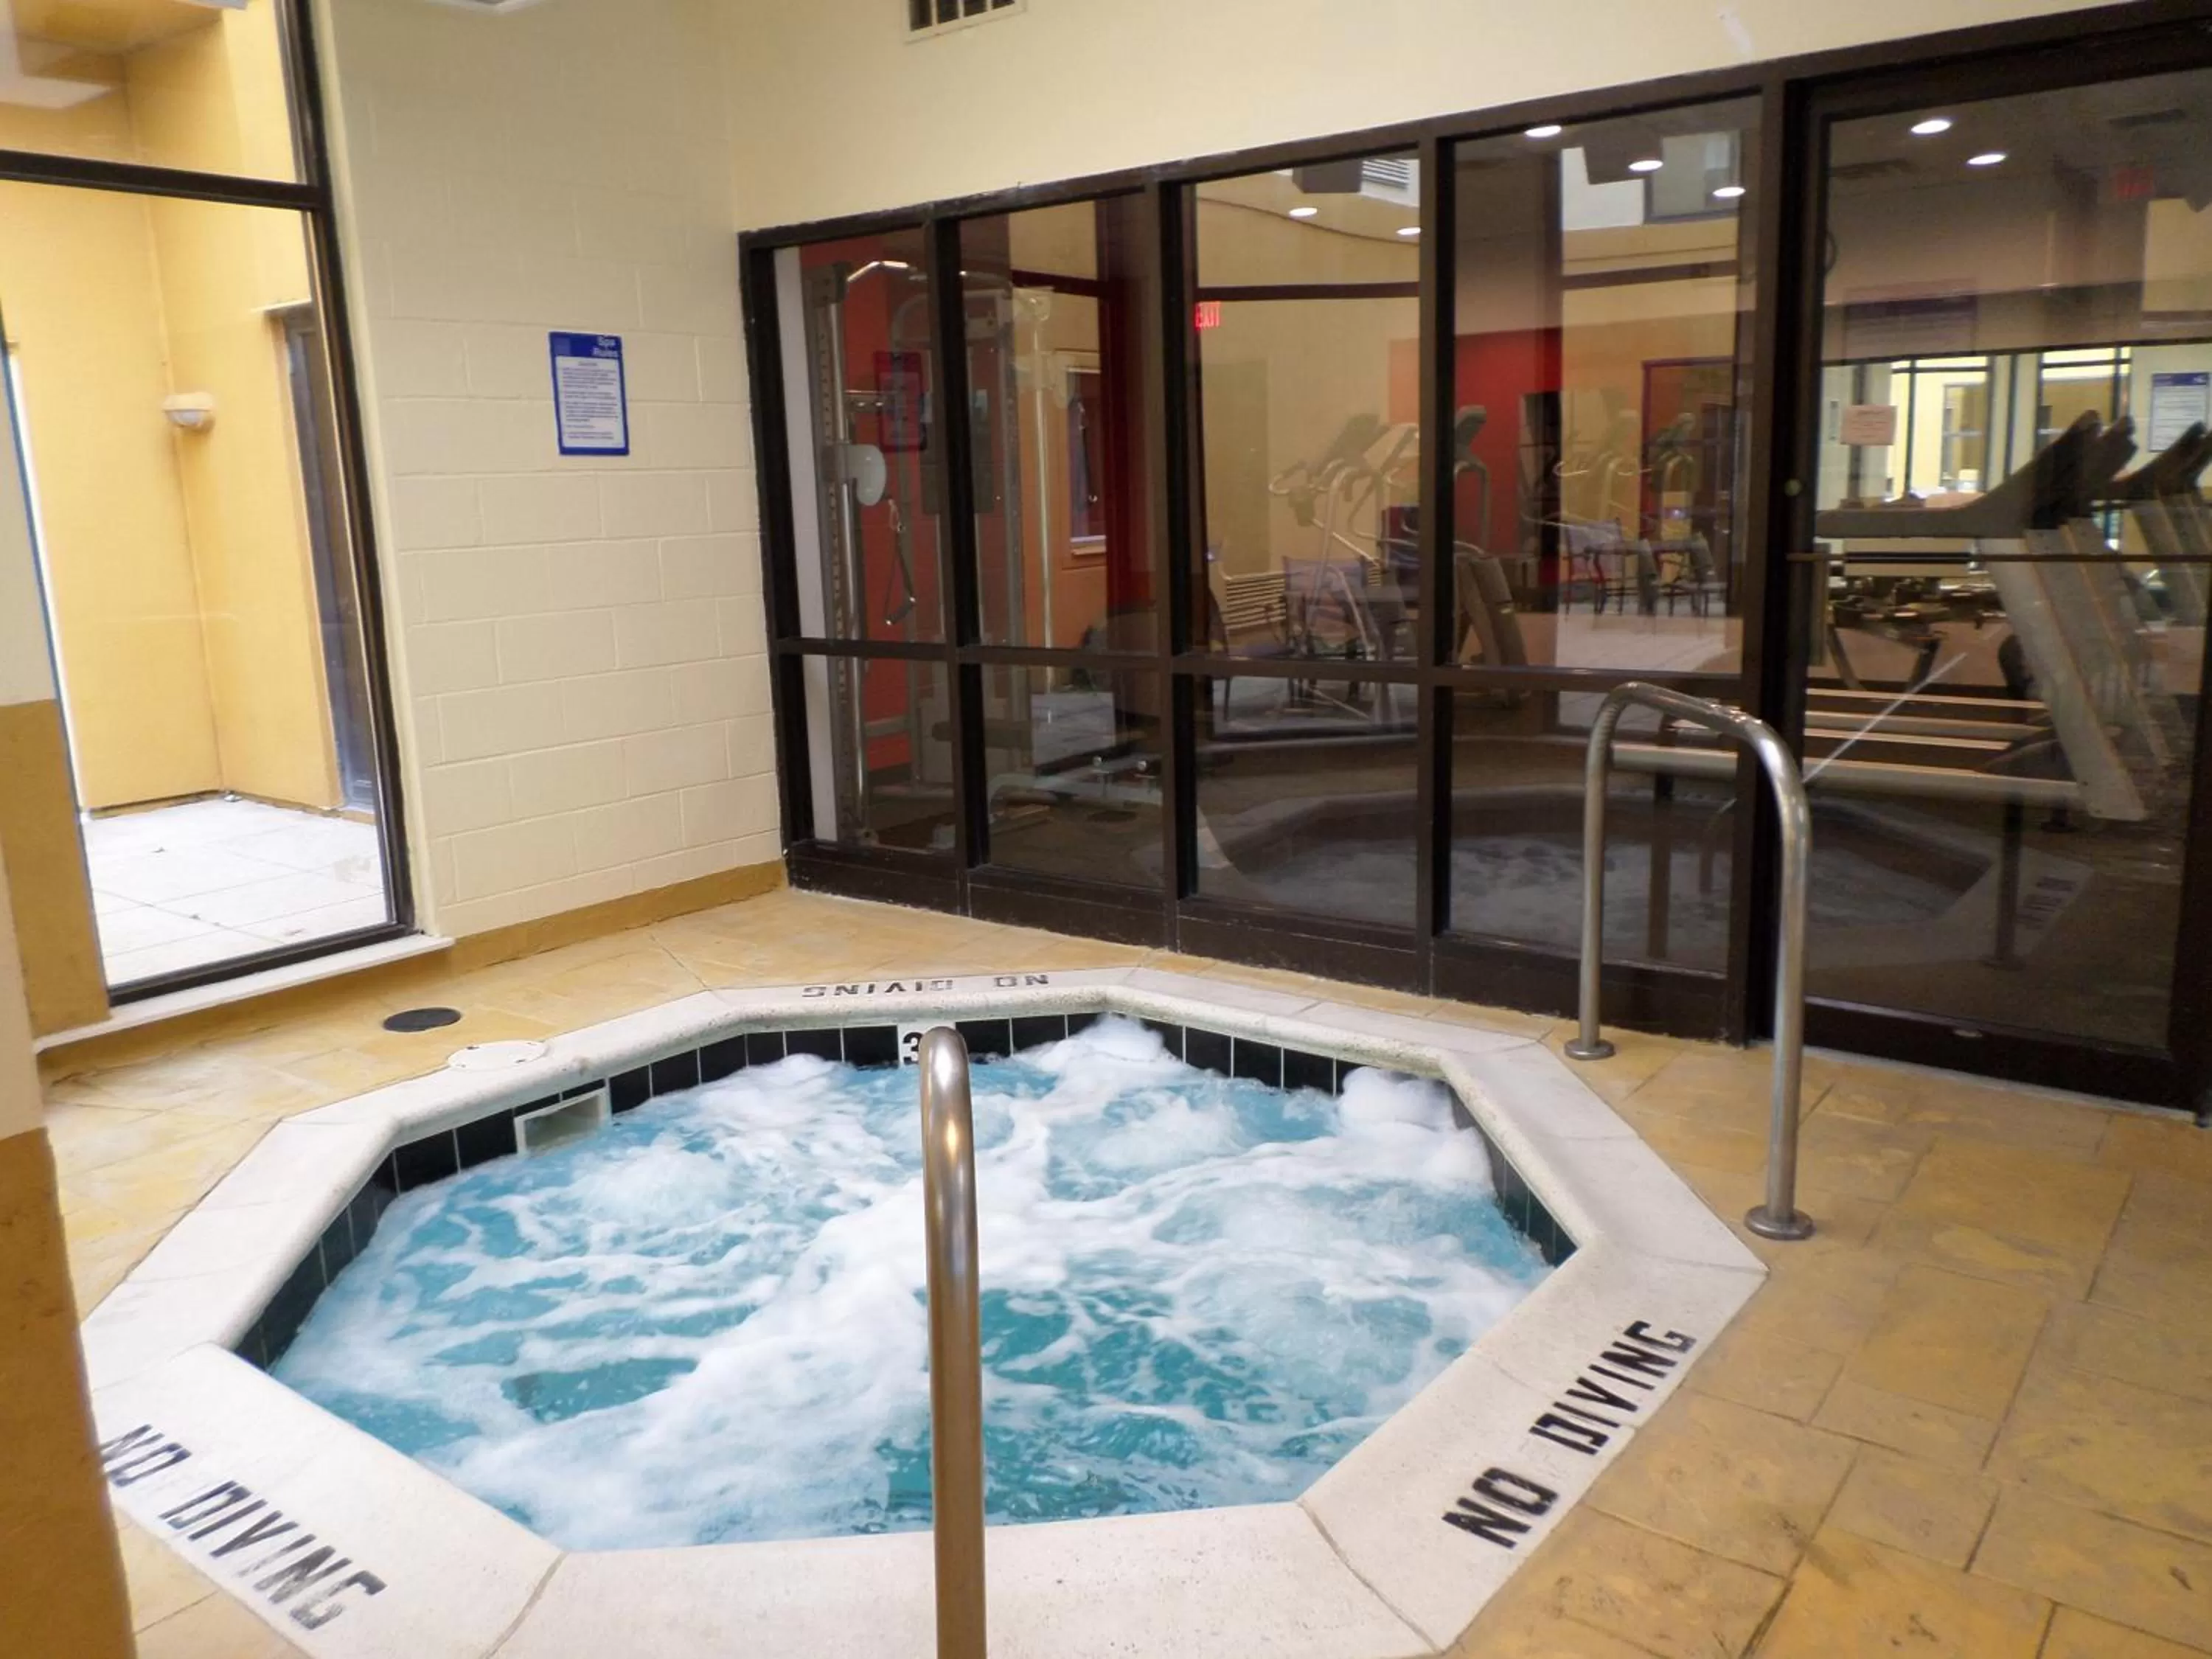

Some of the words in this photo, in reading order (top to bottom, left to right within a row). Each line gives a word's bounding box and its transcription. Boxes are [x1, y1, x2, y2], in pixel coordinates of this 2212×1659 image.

[1194, 301, 1220, 329] EXIT
[801, 979, 953, 998] DIVING
[994, 974, 1048, 987] NO
[1441, 1467, 1558, 1549] NO
[1528, 1321, 1697, 1455] DIVING
[99, 1424, 192, 1487] NO
[158, 1480, 388, 1630] DIVING
